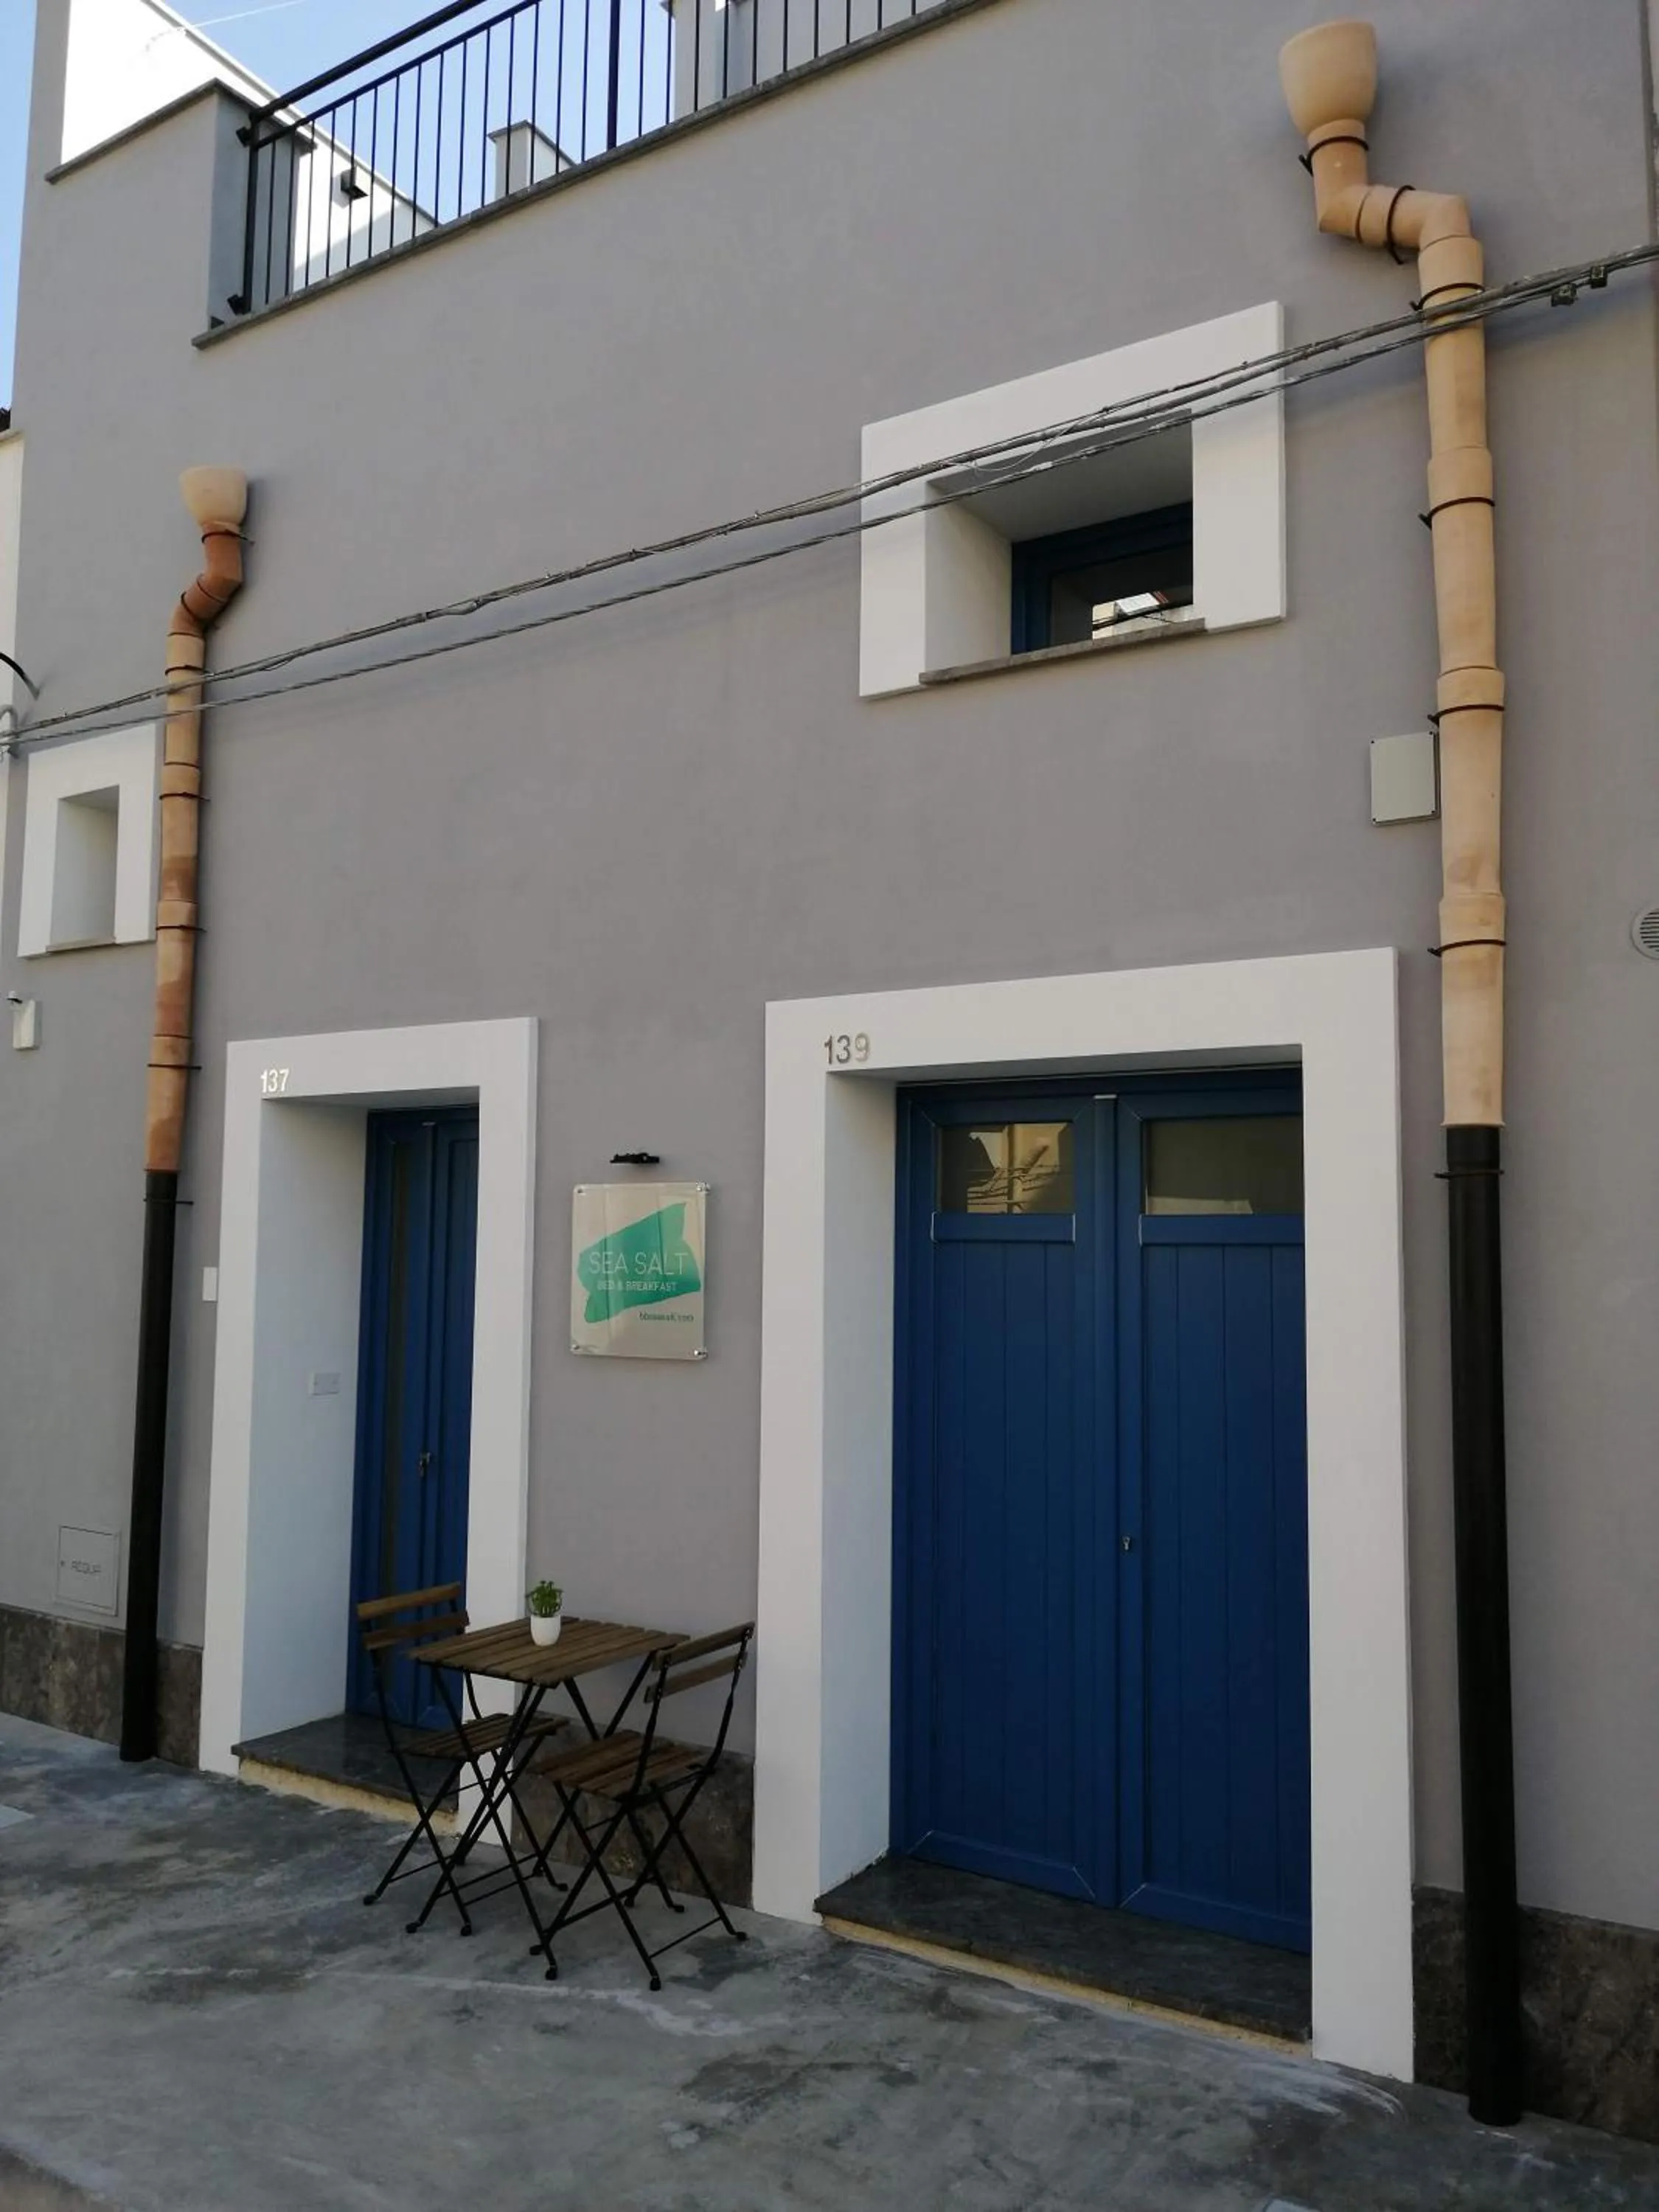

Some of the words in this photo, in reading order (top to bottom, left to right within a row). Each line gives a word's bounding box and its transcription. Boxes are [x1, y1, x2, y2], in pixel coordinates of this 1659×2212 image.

[824, 1032, 869, 1065] 139
[260, 1068, 289, 1093] 137
[589, 1252, 629, 1275] SEA
[635, 1252, 689, 1276] SALT
[626, 1281, 678, 1292] BREAKFAST
